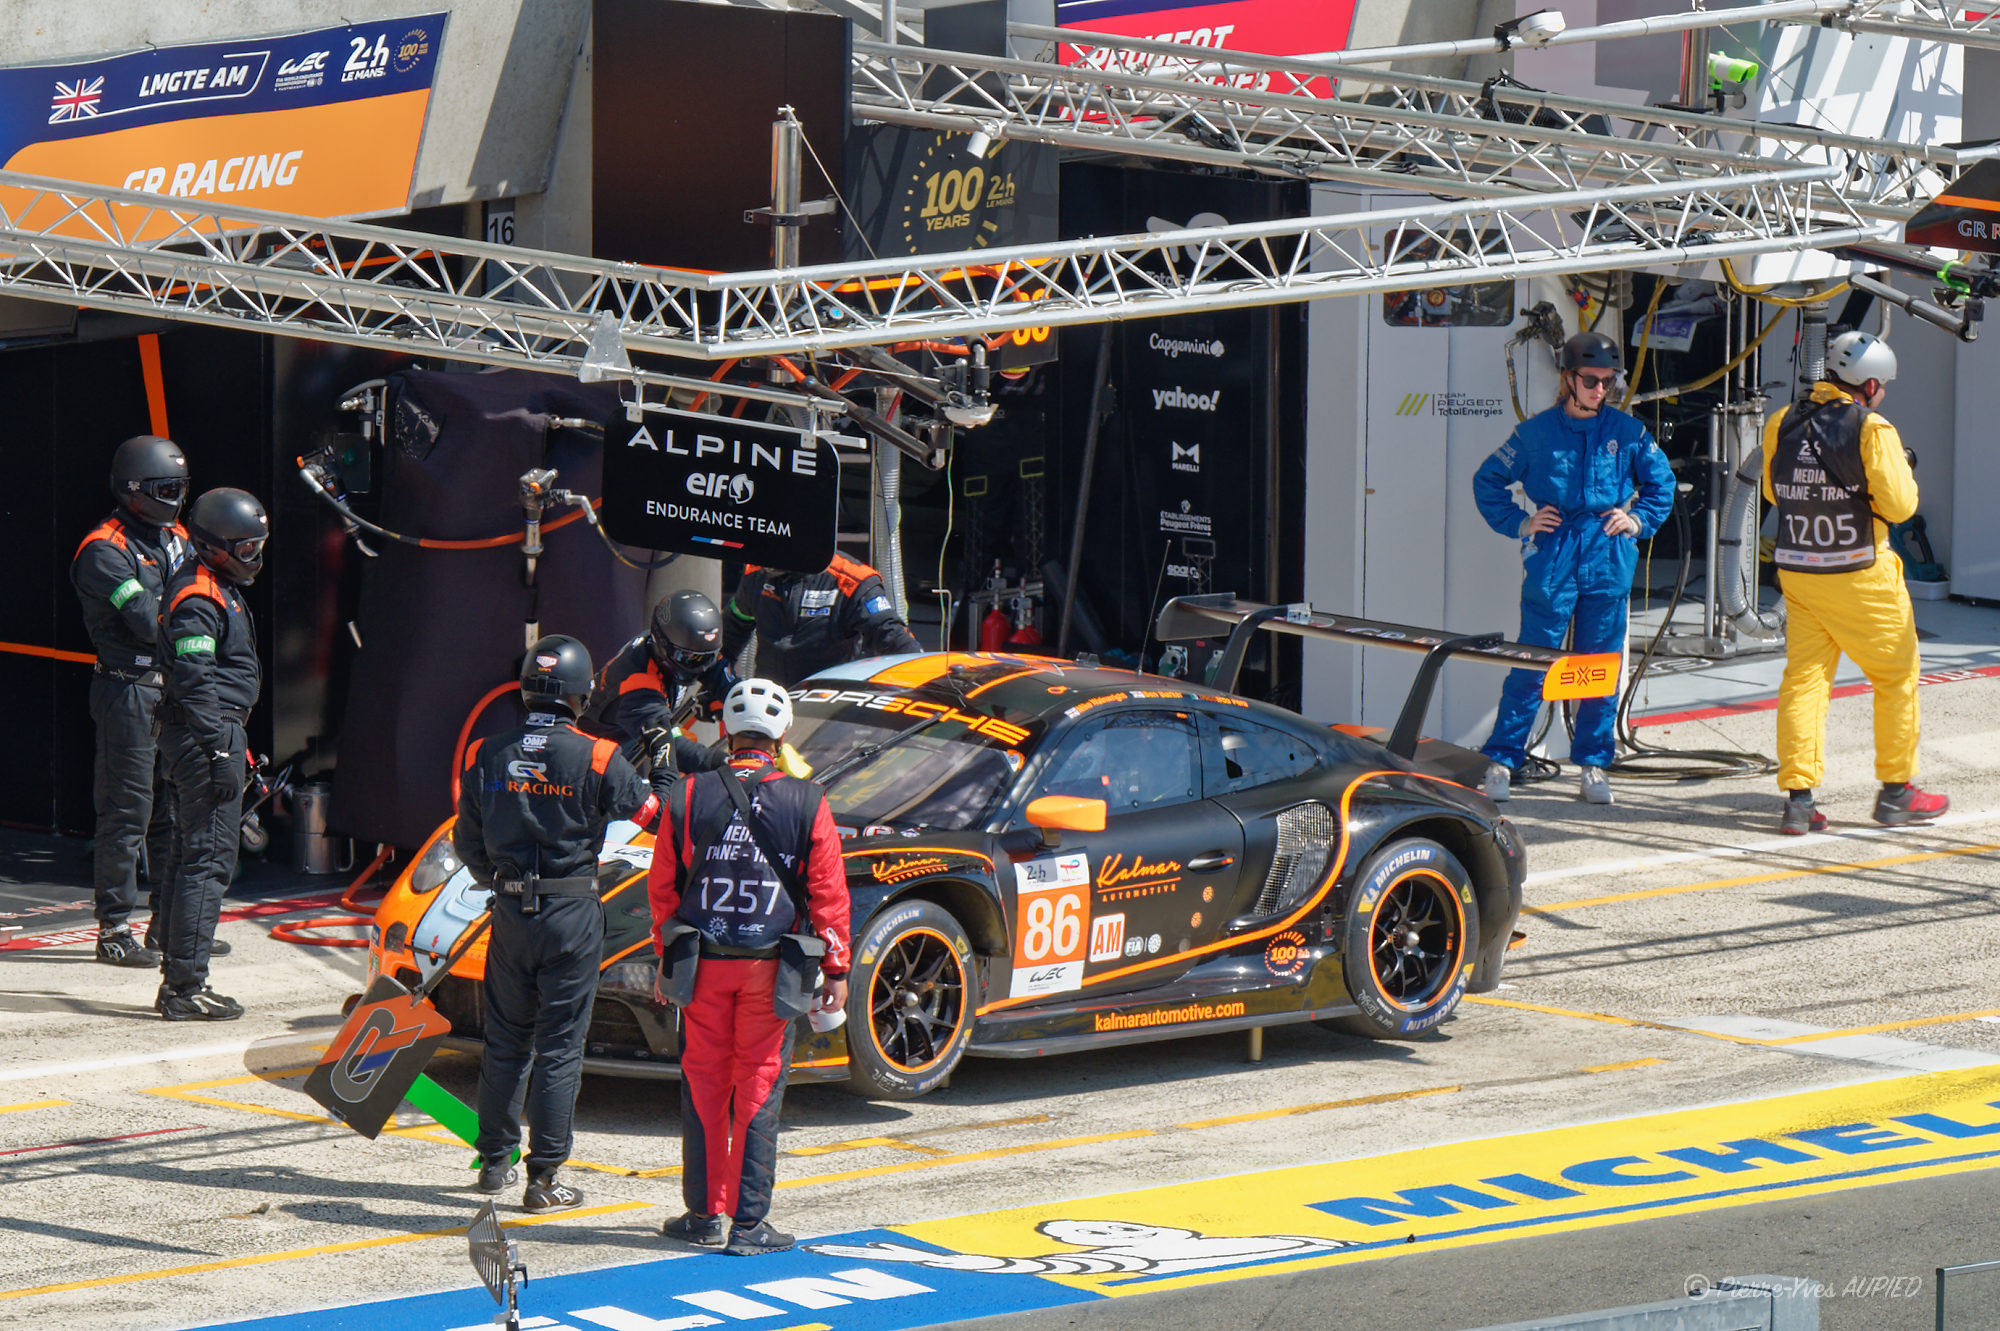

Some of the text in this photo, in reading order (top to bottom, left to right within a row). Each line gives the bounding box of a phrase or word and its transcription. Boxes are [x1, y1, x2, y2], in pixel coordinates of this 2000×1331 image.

[278, 50, 330, 75] WEC
[398, 43, 418, 58] 100
[139, 65, 249, 97] LMGTE AM
[341, 67, 384, 82] LE MANS
[119, 150, 303, 206] GR RACING
[987, 172, 1016, 201] 24h
[920, 166, 985, 218] 100
[489, 216, 514, 245] 16
[926, 213, 971, 231] YEARS
[1957, 219, 1987, 239] GR
[1149, 333, 1210, 358] Capgemini
[1152, 386, 1220, 412] yahoo!
[1438, 398, 1503, 406] PEUGEOT
[1438, 407, 1503, 417] TotalEnergies
[627, 424, 817, 476] ALPINE
[1172, 462, 1200, 473] MARELLI
[1793, 467, 1826, 484] MEDIA
[686, 472, 730, 499] elf
[1775, 483, 1810, 501] PITLANE
[646, 500, 791, 538] ENDURANCE TEAM
[1160, 518, 1211, 532] Peugeot Frères
[1785, 513, 1858, 547] 1205
[178, 640, 212, 651] PITLANE
[787, 688, 1031, 747] PORSCHE
[522, 736, 548, 747] OMP
[484, 781, 573, 797] GR RACING
[872, 857, 942, 880] Kalmar
[1096, 852, 1181, 888] Kalmar
[1375, 849, 1431, 889] MICHELIN
[700, 876, 780, 916] 1257
[1102, 883, 1177, 903] AUTOMOTIVE
[738, 923, 765, 932] WEC
[875, 908, 920, 945] MICHELIN
[1023, 893, 1081, 961] 86
[1093, 920, 1122, 956] AM
[1126, 940, 1142, 952] FIA
[1270, 945, 1297, 962] 100
[1030, 966, 1067, 983] WEC
[1095, 1001, 1245, 1032] kalmarautomotive.com
[1405, 988, 1460, 1032] MICHELIN
